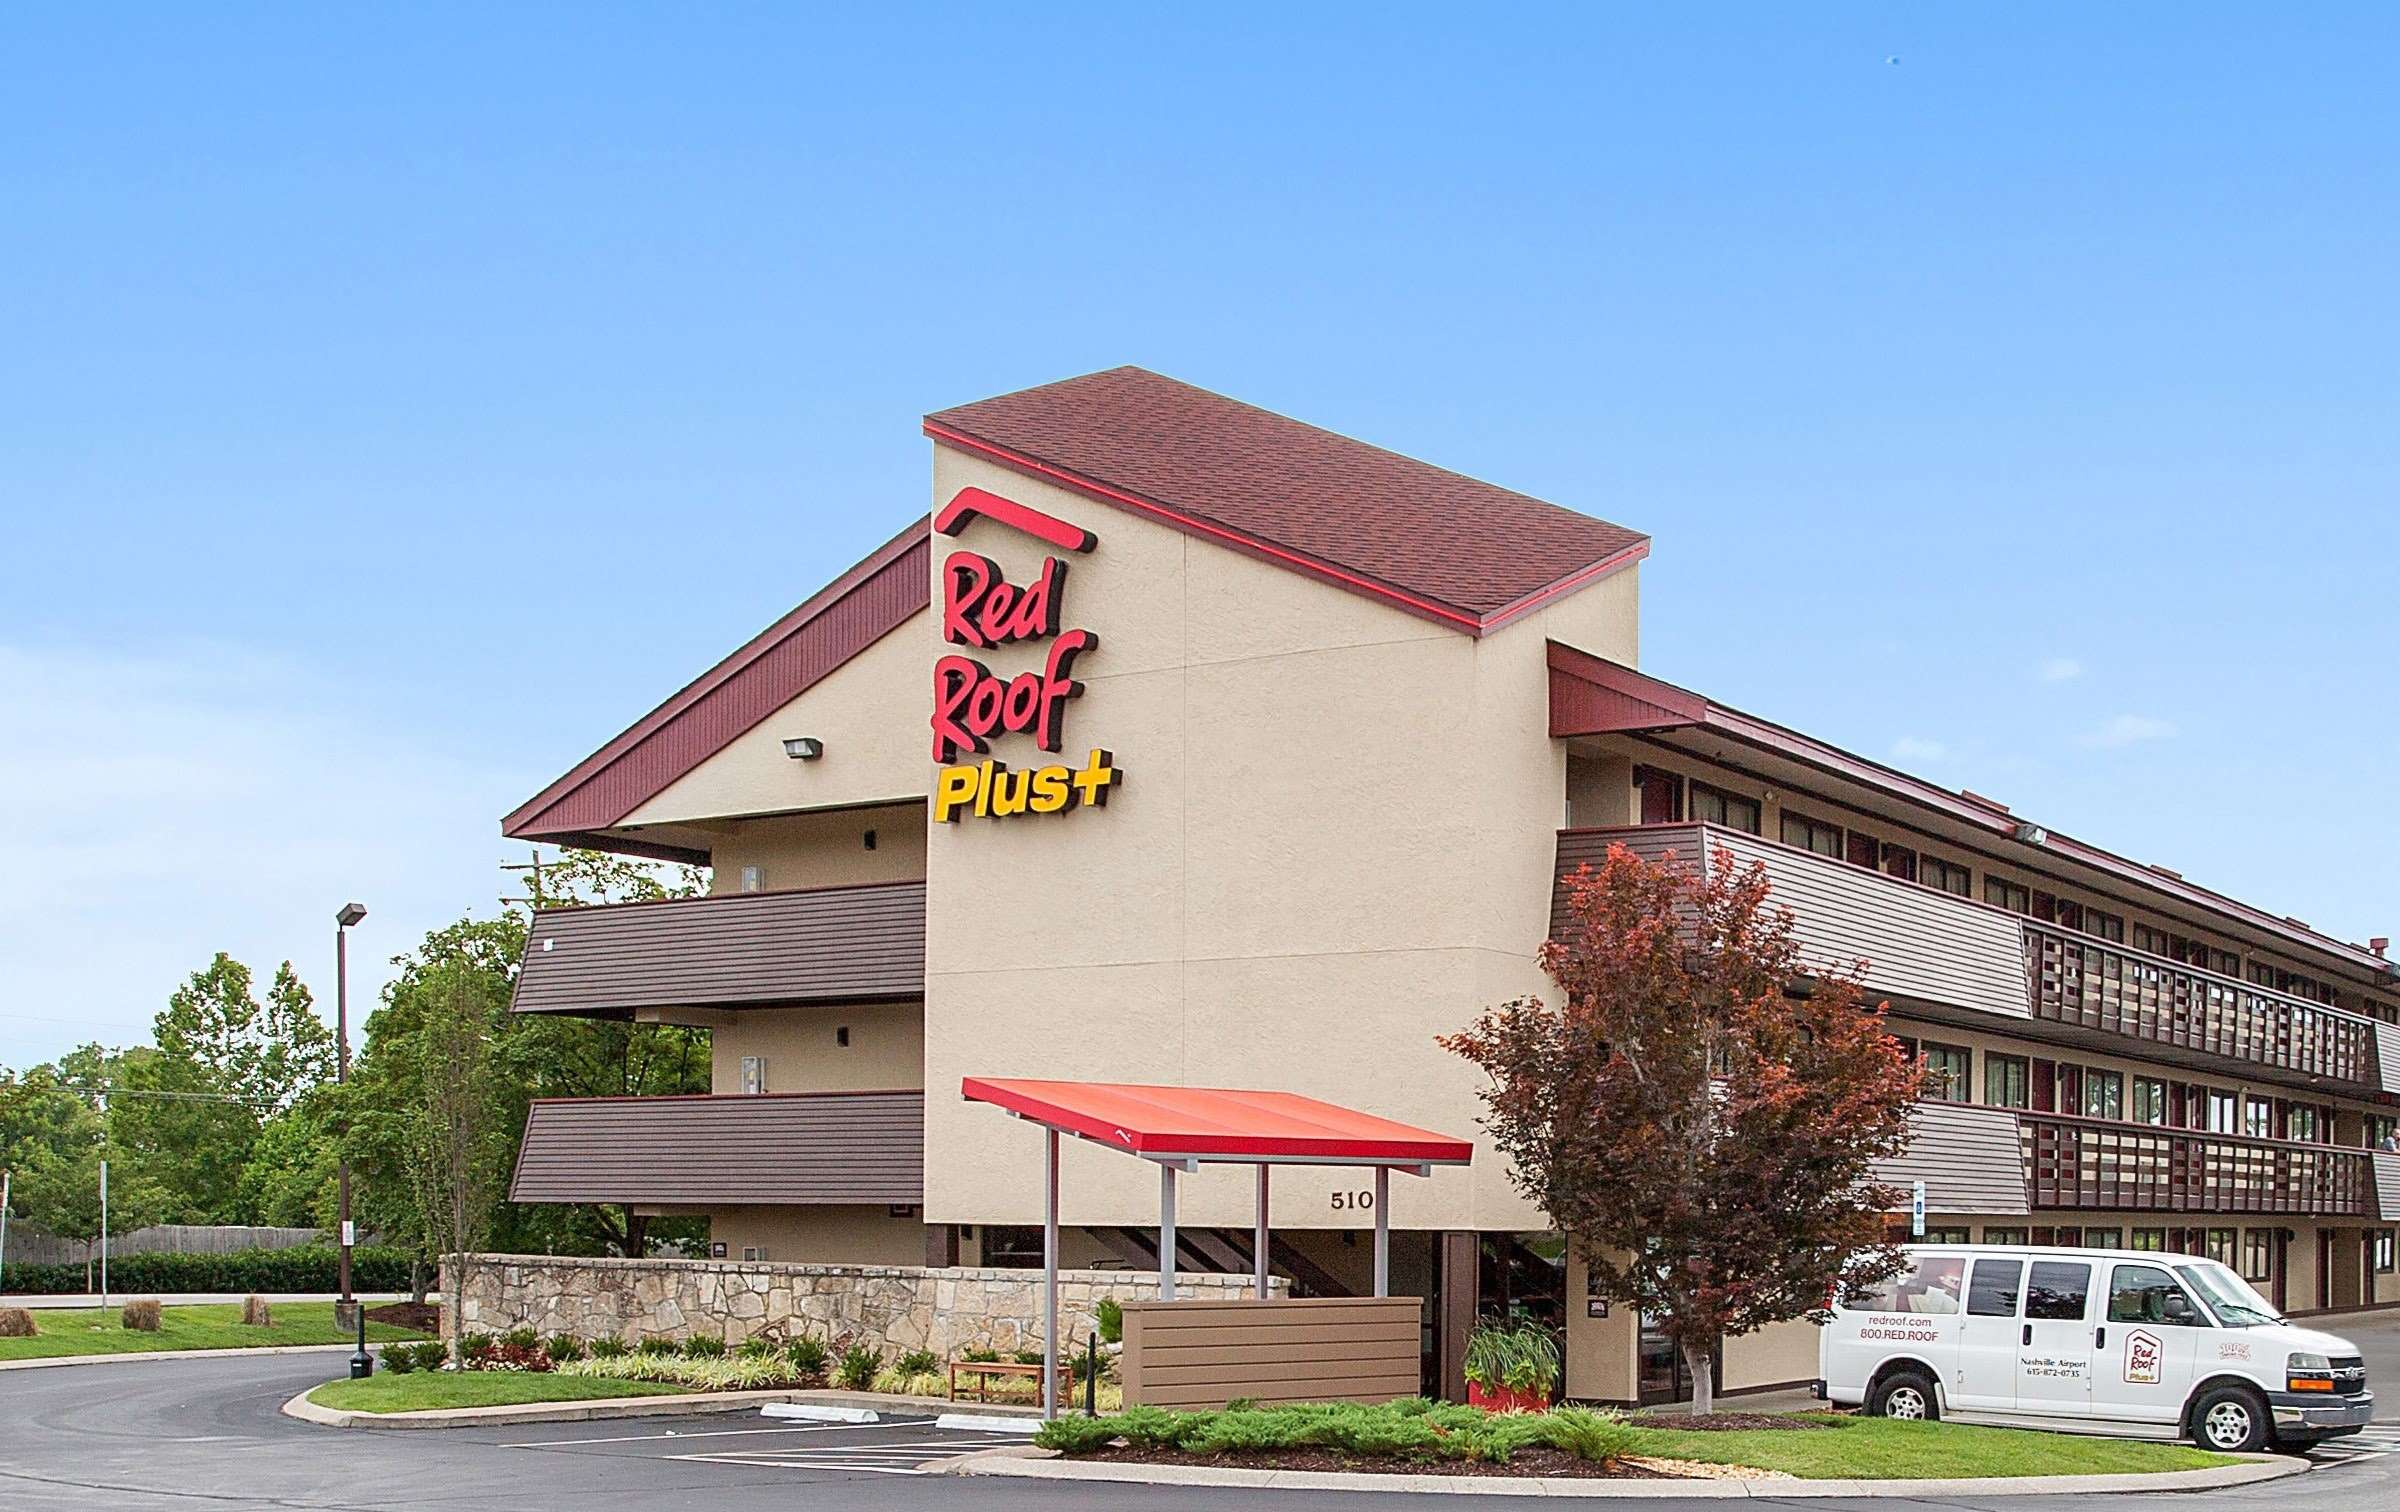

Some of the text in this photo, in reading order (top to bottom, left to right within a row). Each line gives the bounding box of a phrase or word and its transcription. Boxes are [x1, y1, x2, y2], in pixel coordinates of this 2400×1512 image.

[943, 551, 1068, 649] Red
[931, 629, 1099, 764] Roof
[1331, 1190, 1374, 1210] 510
[1868, 1315, 1933, 1328] redroof.com
[1860, 1328, 1940, 1342] 800.RED.ROOF
[2134, 1344, 2154, 1358] Red
[2057, 1360, 2087, 1369] Airport
[2130, 1356, 2157, 1371] Roof
